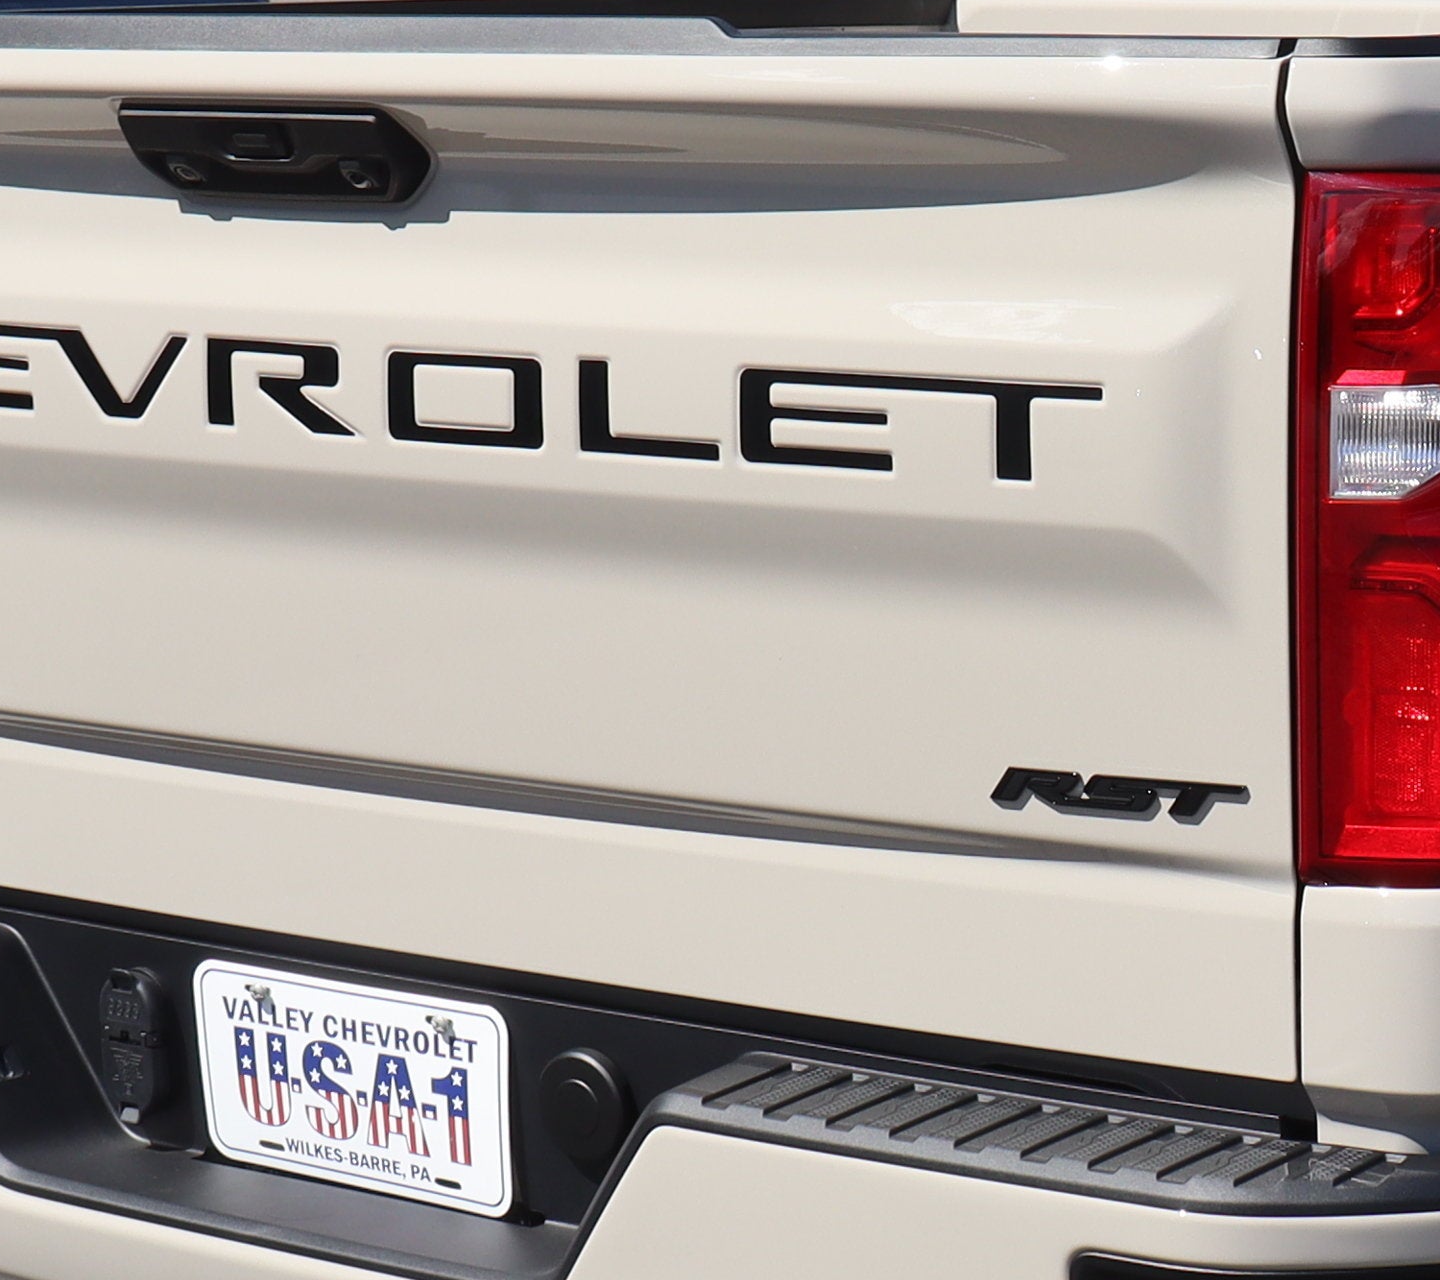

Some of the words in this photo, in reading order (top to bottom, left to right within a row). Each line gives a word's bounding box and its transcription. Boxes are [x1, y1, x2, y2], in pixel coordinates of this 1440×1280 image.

[990, 766, 1252, 825] RST
[221, 995, 314, 1035] VALLEY
[322, 1014, 478, 1064] CHEVROLET
[285, 1137, 407, 1181] WILKES-BARRE,
[410, 1164, 432, 1183] PA
